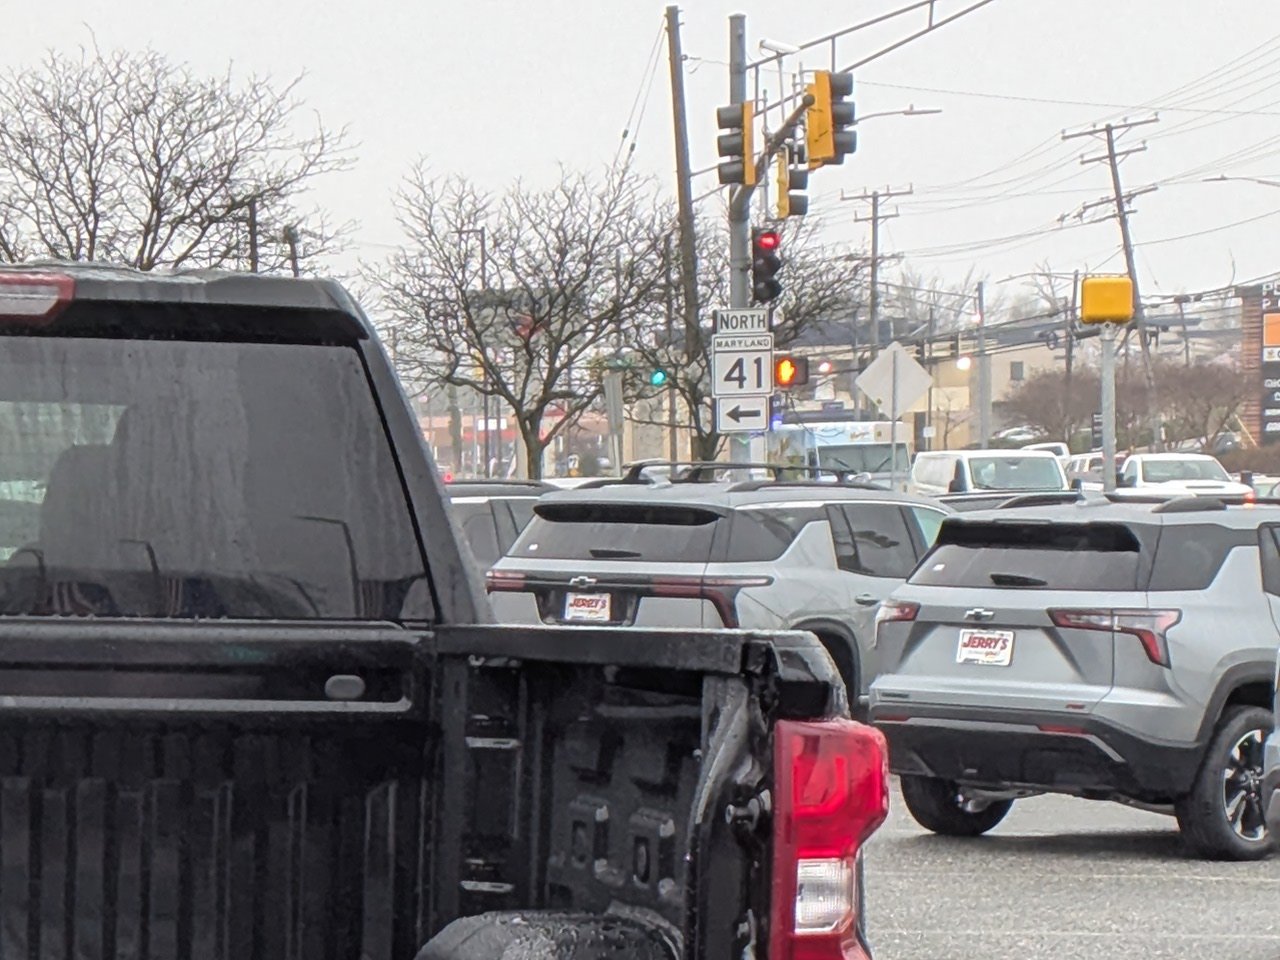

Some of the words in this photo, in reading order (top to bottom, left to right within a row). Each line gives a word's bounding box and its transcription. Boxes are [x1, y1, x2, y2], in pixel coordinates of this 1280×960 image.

[720, 314, 766, 330] NORTH
[716, 339, 769, 348] MARYLAND
[724, 356, 762, 389] 41
[962, 635, 1010, 651] JERRY'S
